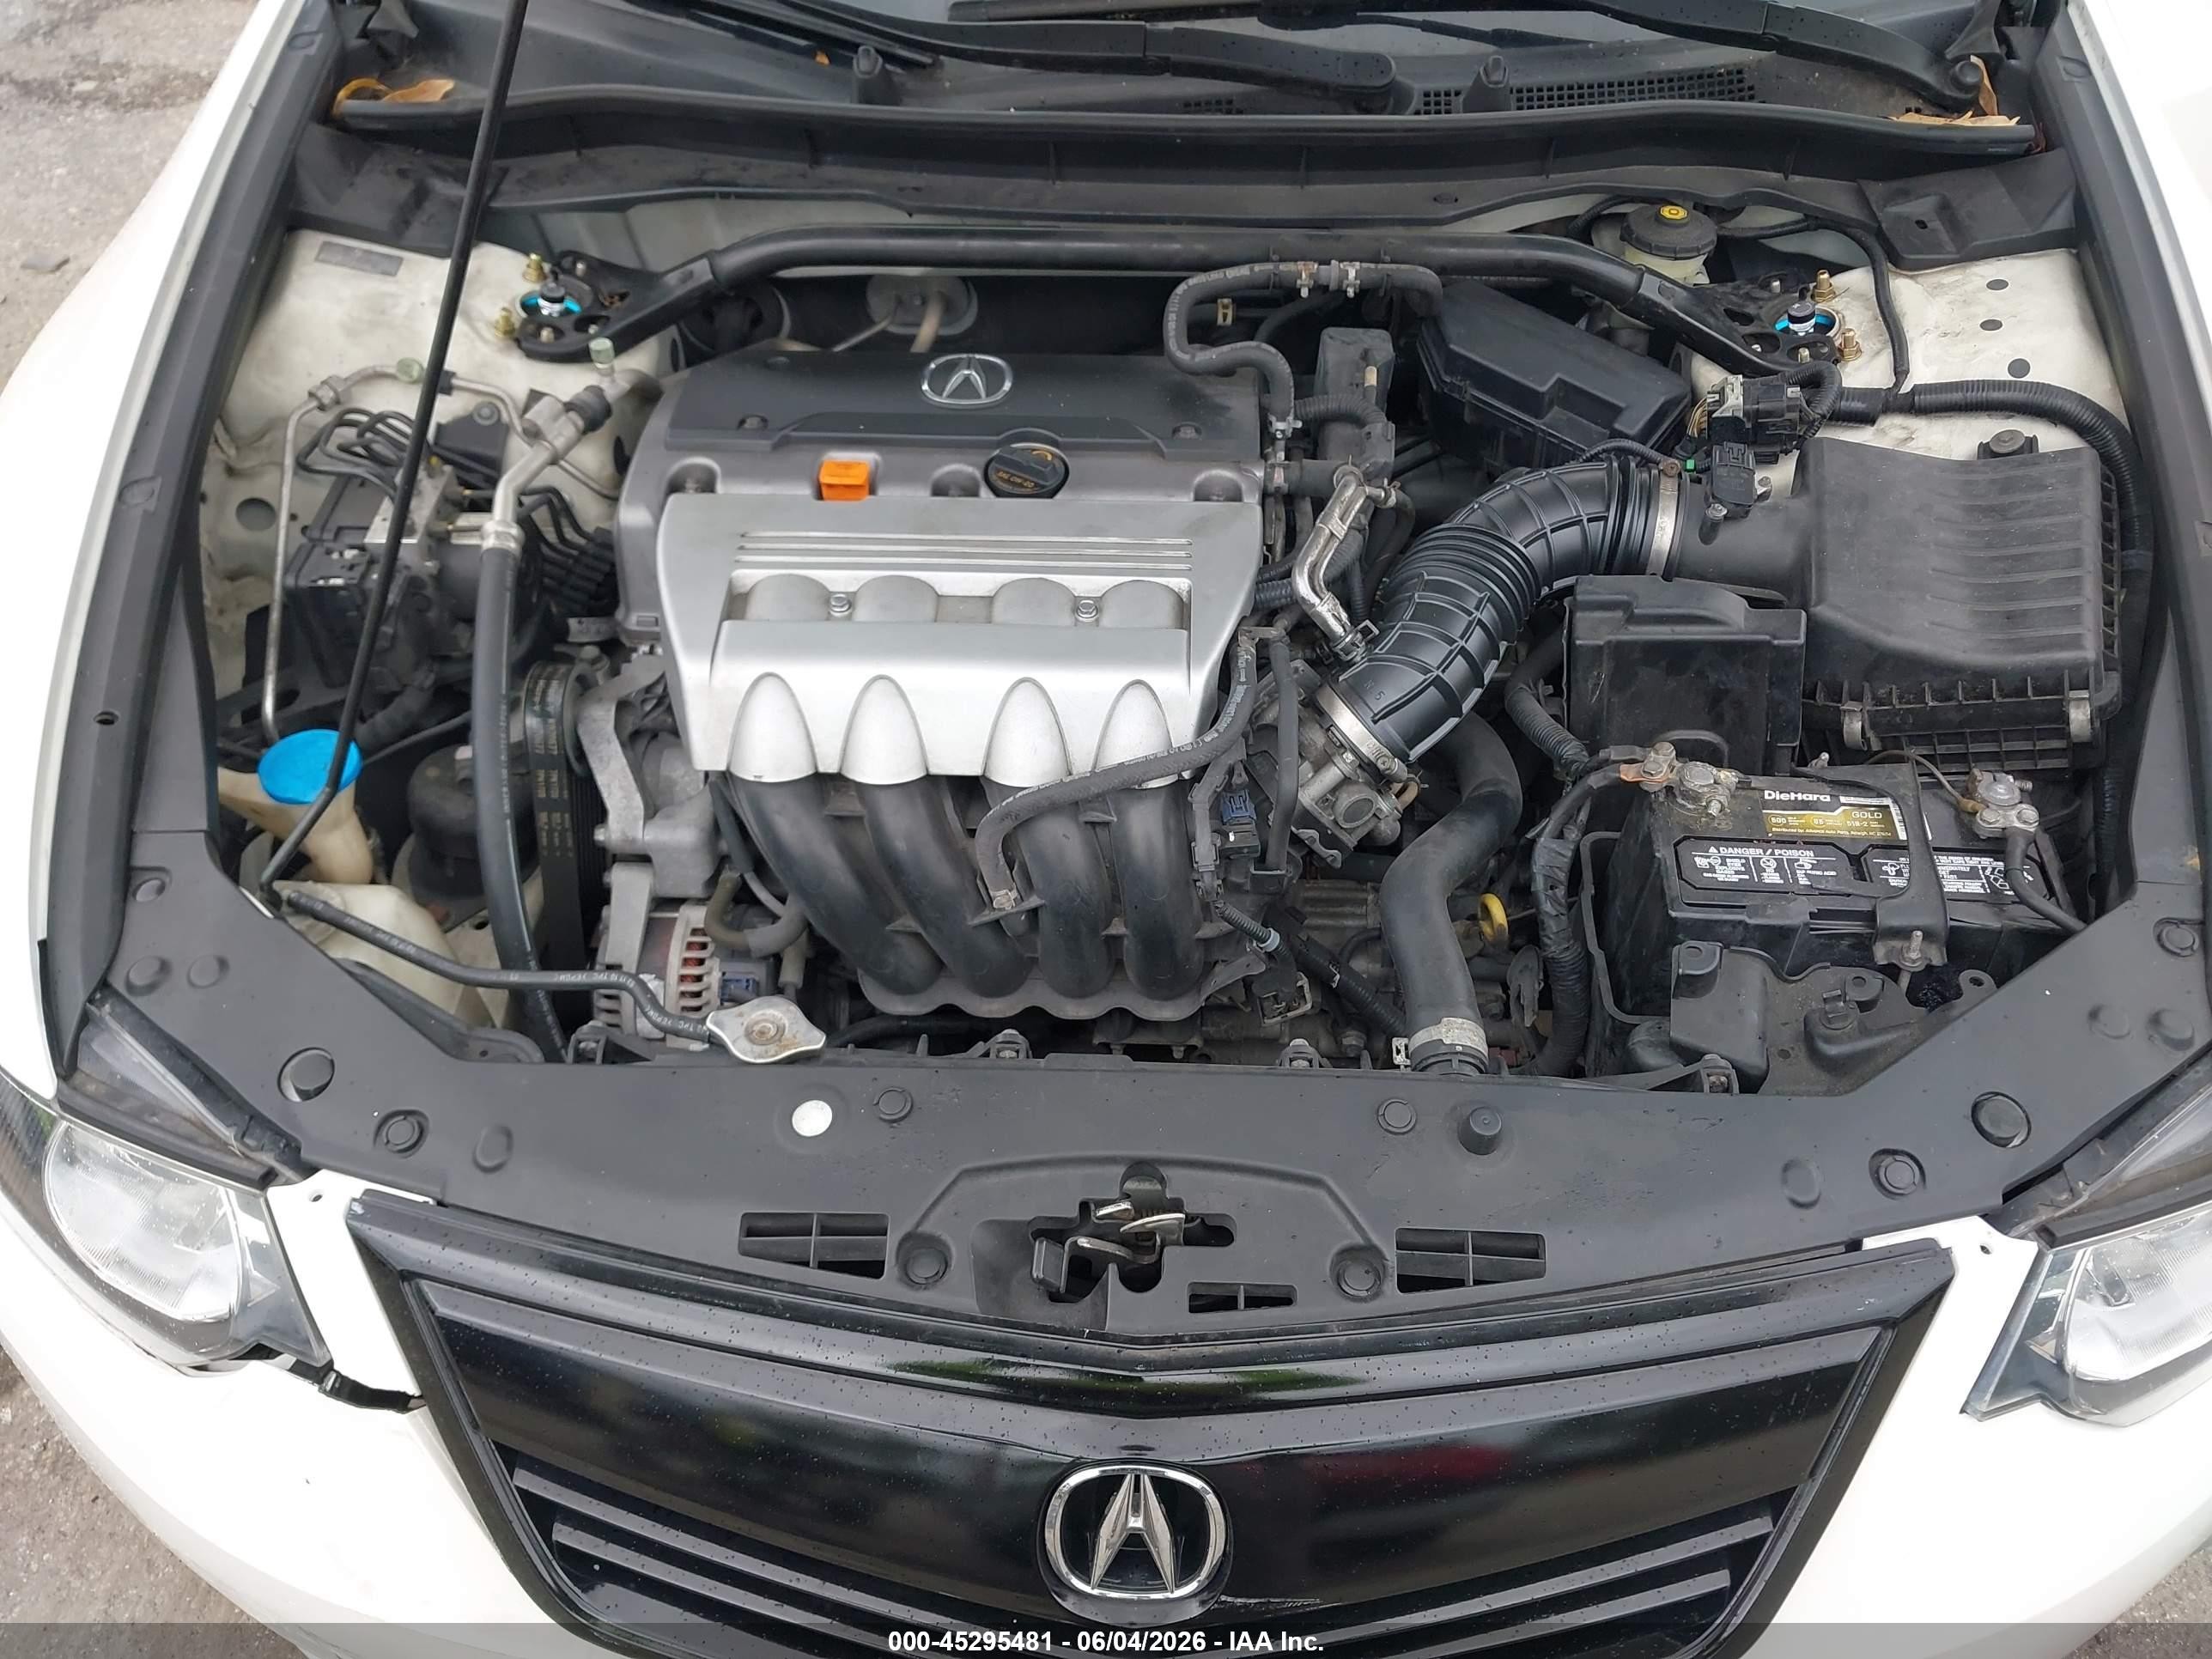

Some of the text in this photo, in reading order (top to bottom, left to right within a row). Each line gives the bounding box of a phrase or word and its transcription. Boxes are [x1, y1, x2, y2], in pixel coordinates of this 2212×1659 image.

[1851, 811, 1883, 819] GOLD
[1719, 847, 1764, 855] DANGER
[1774, 848, 1814, 858] POISON
